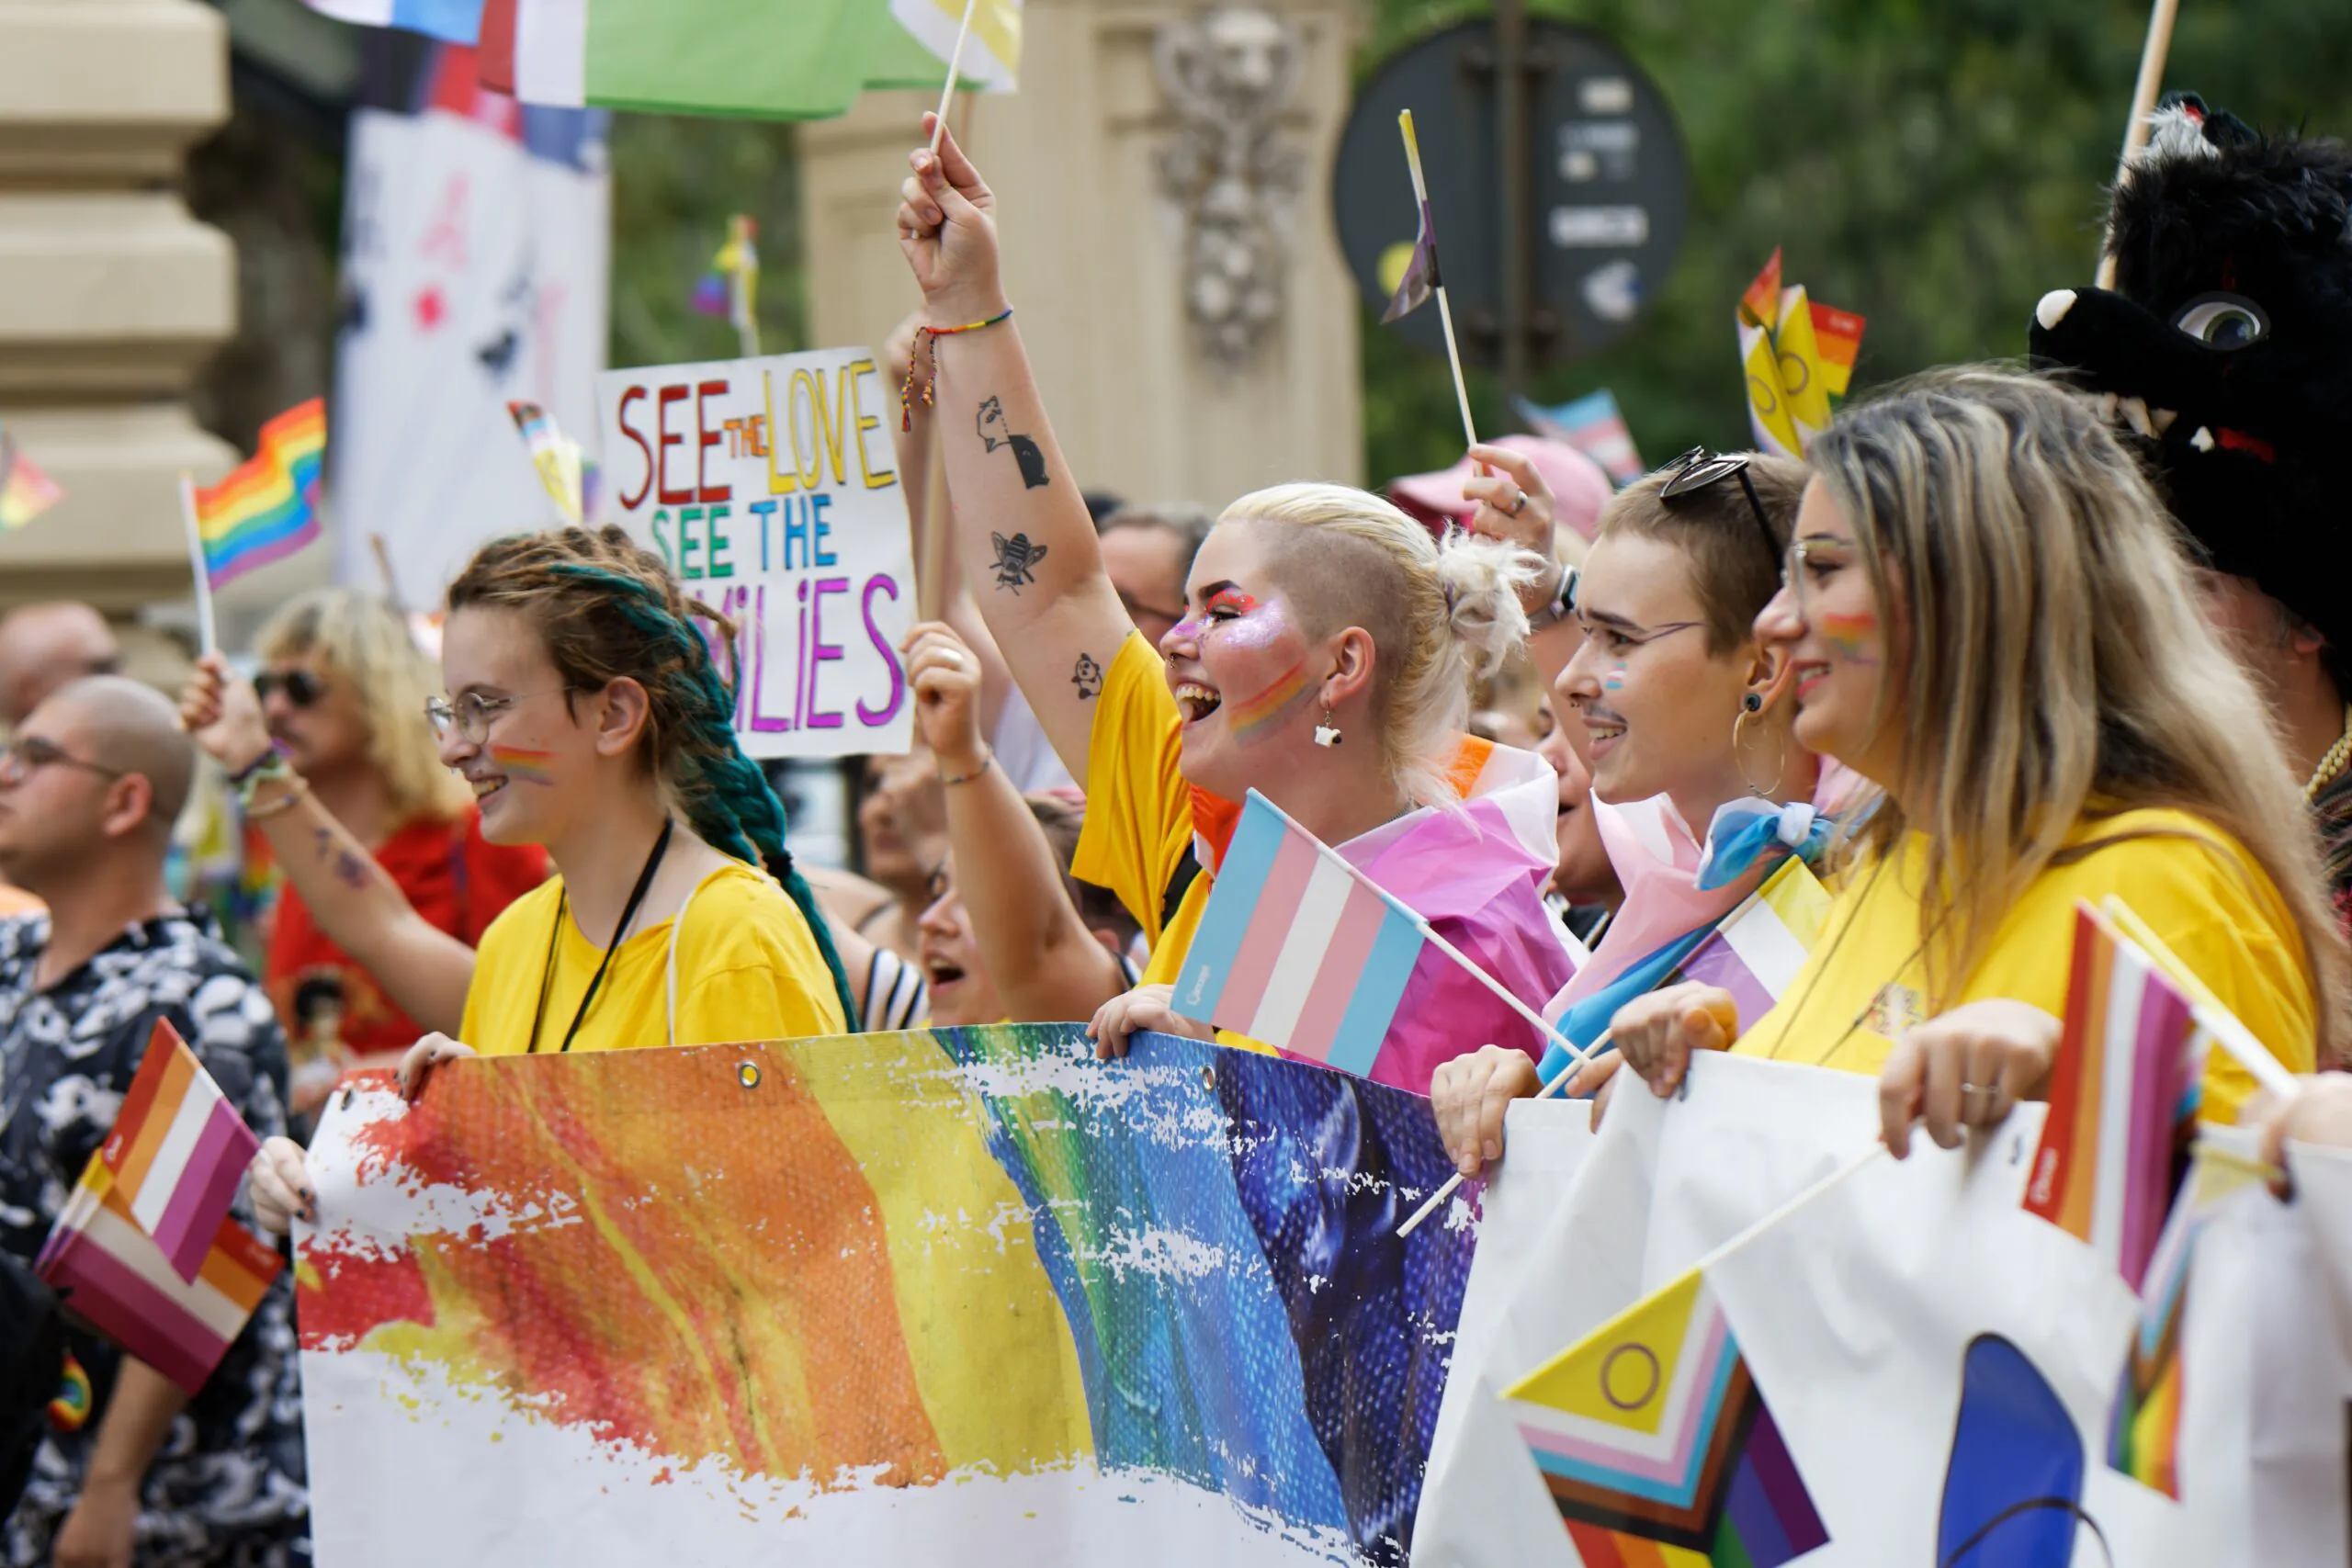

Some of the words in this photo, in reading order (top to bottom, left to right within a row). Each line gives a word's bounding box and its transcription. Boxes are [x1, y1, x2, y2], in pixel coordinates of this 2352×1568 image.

[618, 379, 731, 510] SEE
[723, 413, 770, 459] THE
[763, 359, 897, 494] LOVE
[651, 504, 734, 580] SEE
[749, 493, 838, 572] THE
